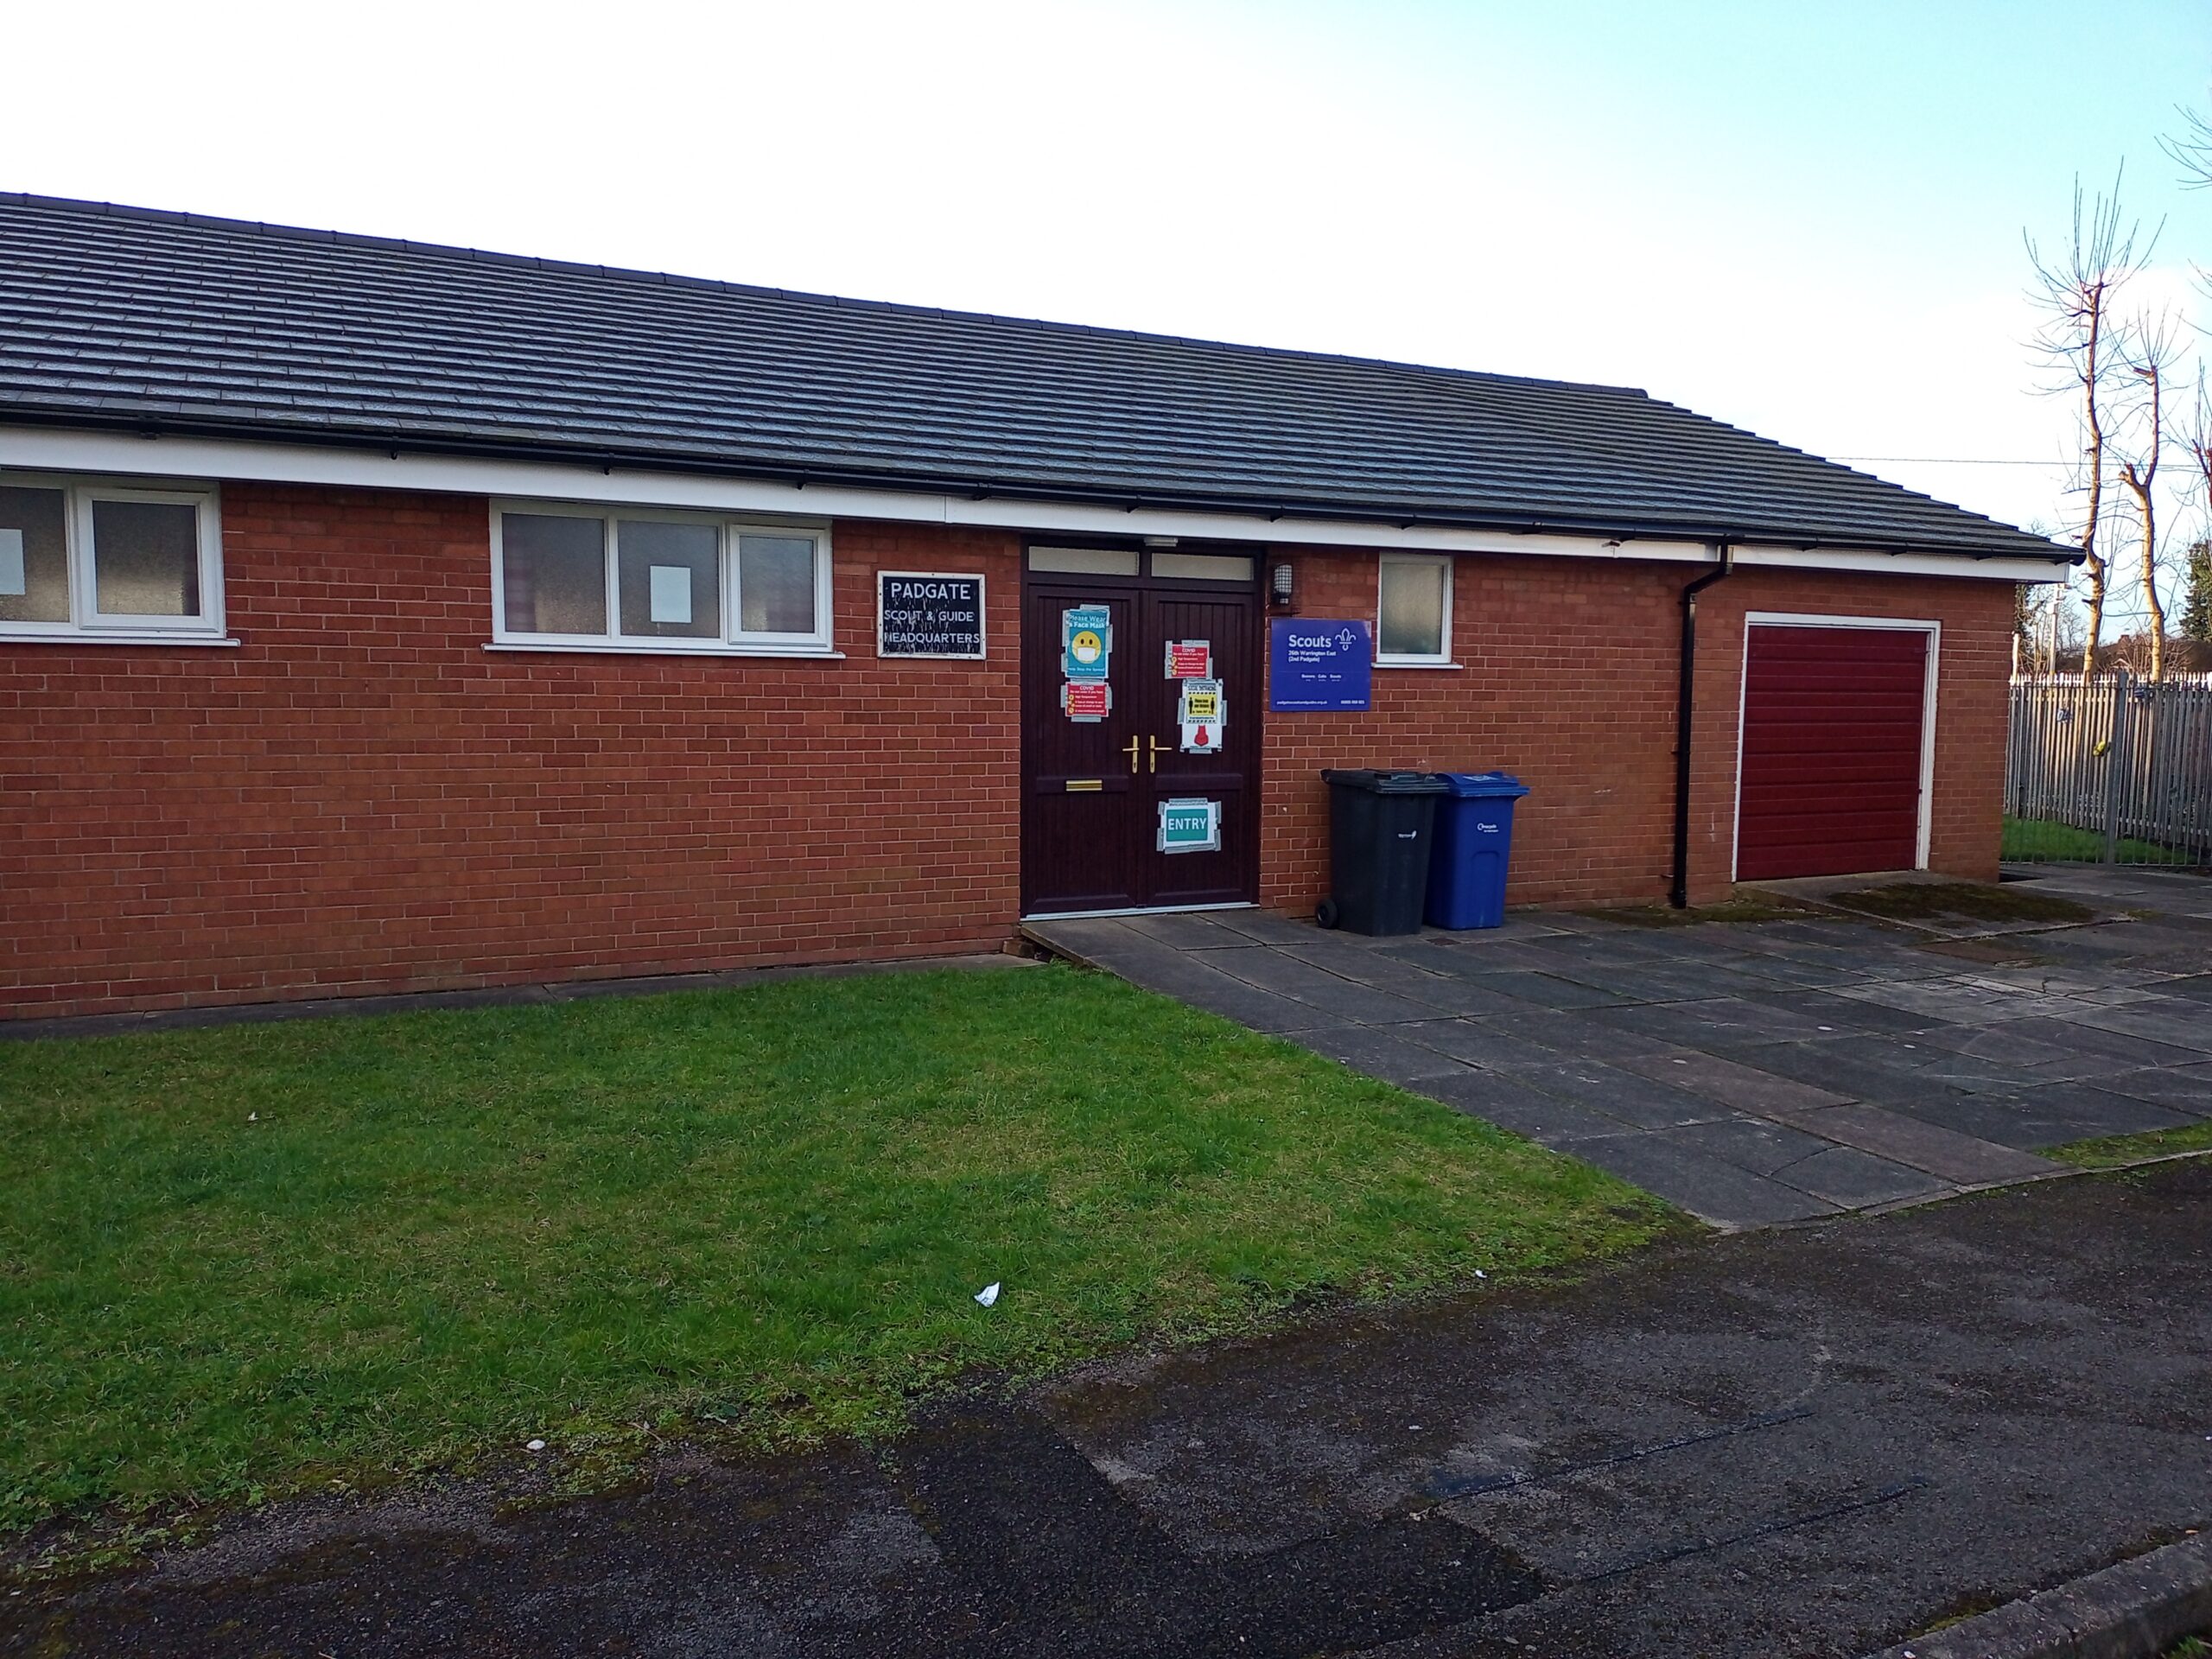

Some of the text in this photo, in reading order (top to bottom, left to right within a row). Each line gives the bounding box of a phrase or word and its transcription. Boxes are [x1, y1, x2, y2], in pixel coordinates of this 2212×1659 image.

[891, 582, 971, 600] PADGATE
[884, 609, 975, 621] SCOUT & GUIDE
[884, 632, 980, 644] HEADQUARTERS
[1288, 634, 1332, 648] Scouts
[1168, 817, 1207, 830] ENTRY
